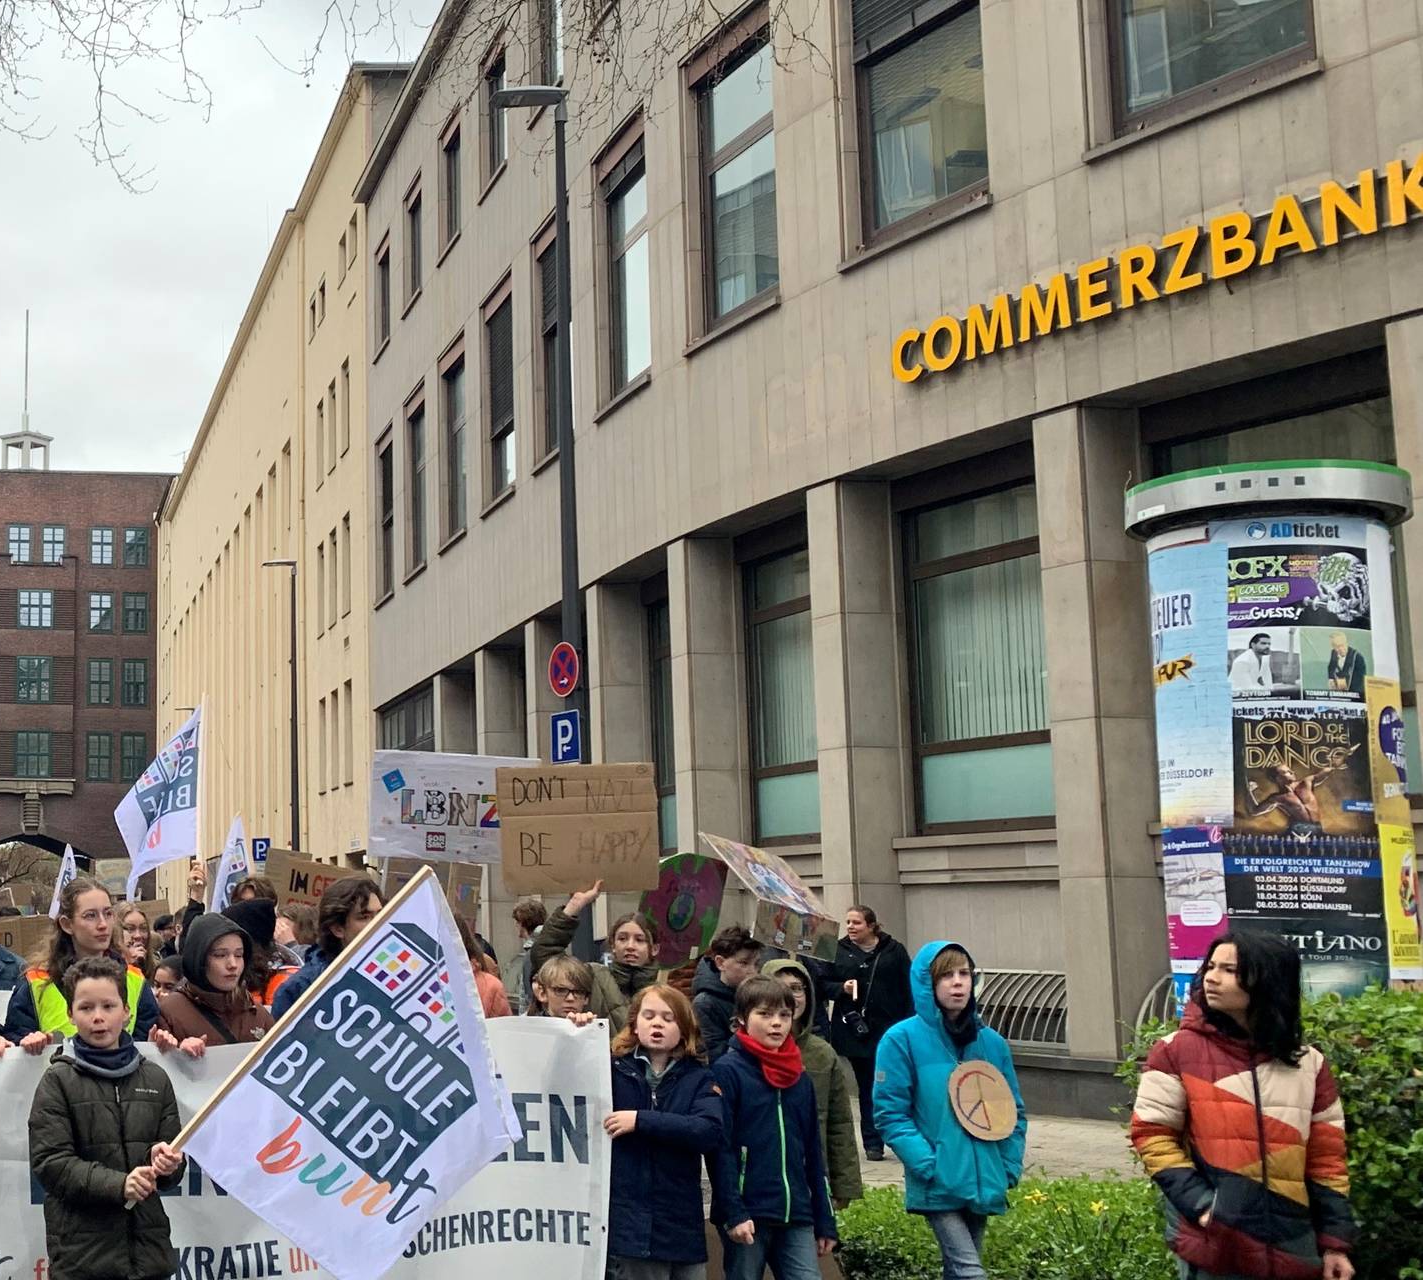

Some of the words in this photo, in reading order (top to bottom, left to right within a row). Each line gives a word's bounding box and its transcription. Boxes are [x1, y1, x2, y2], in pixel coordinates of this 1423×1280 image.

[892, 153, 1423, 383] COMMERZBANK
[1271, 523, 1340, 538] ADticket
[1239, 584, 1286, 595] COLOGNE
[1232, 706, 1265, 717] ickets
[1244, 720, 1323, 746] LORD
[1327, 723, 1345, 733] OF
[557, 719, 573, 760] P
[1325, 733, 1349, 744] THE
[1166, 768, 1215, 779] DÜSSELDORF
[512, 776, 567, 807] DON'T
[256, 841, 267, 861] P
[519, 831, 553, 867] BE
[1243, 865, 1259, 873] DER
[1313, 867, 1345, 875] WIEDER
[1251, 858, 1322, 866] ERFOLGREICHSTE
[1326, 859, 1371, 868] TANZSHOW
[1300, 876, 1345, 884] DORTMUND
[1256, 884, 1298, 892] 14.04.2024
[1300, 884, 1347, 893] DÜSSELDORF
[1300, 892, 1323, 901] KÖLN
[1256, 901, 1299, 909] 08.05.2024
[1301, 902, 1352, 911] OBERHAUSEN
[314, 989, 470, 1126] SCHULE
[263, 1040, 418, 1178] BLEIBT
[489, 1092, 589, 1164] EN
[256, 1116, 437, 1225] bunt
[176, 1240, 283, 1280] KRATIE
[289, 1246, 319, 1275] un
[402, 1208, 591, 1259] SCHENRECHTE
